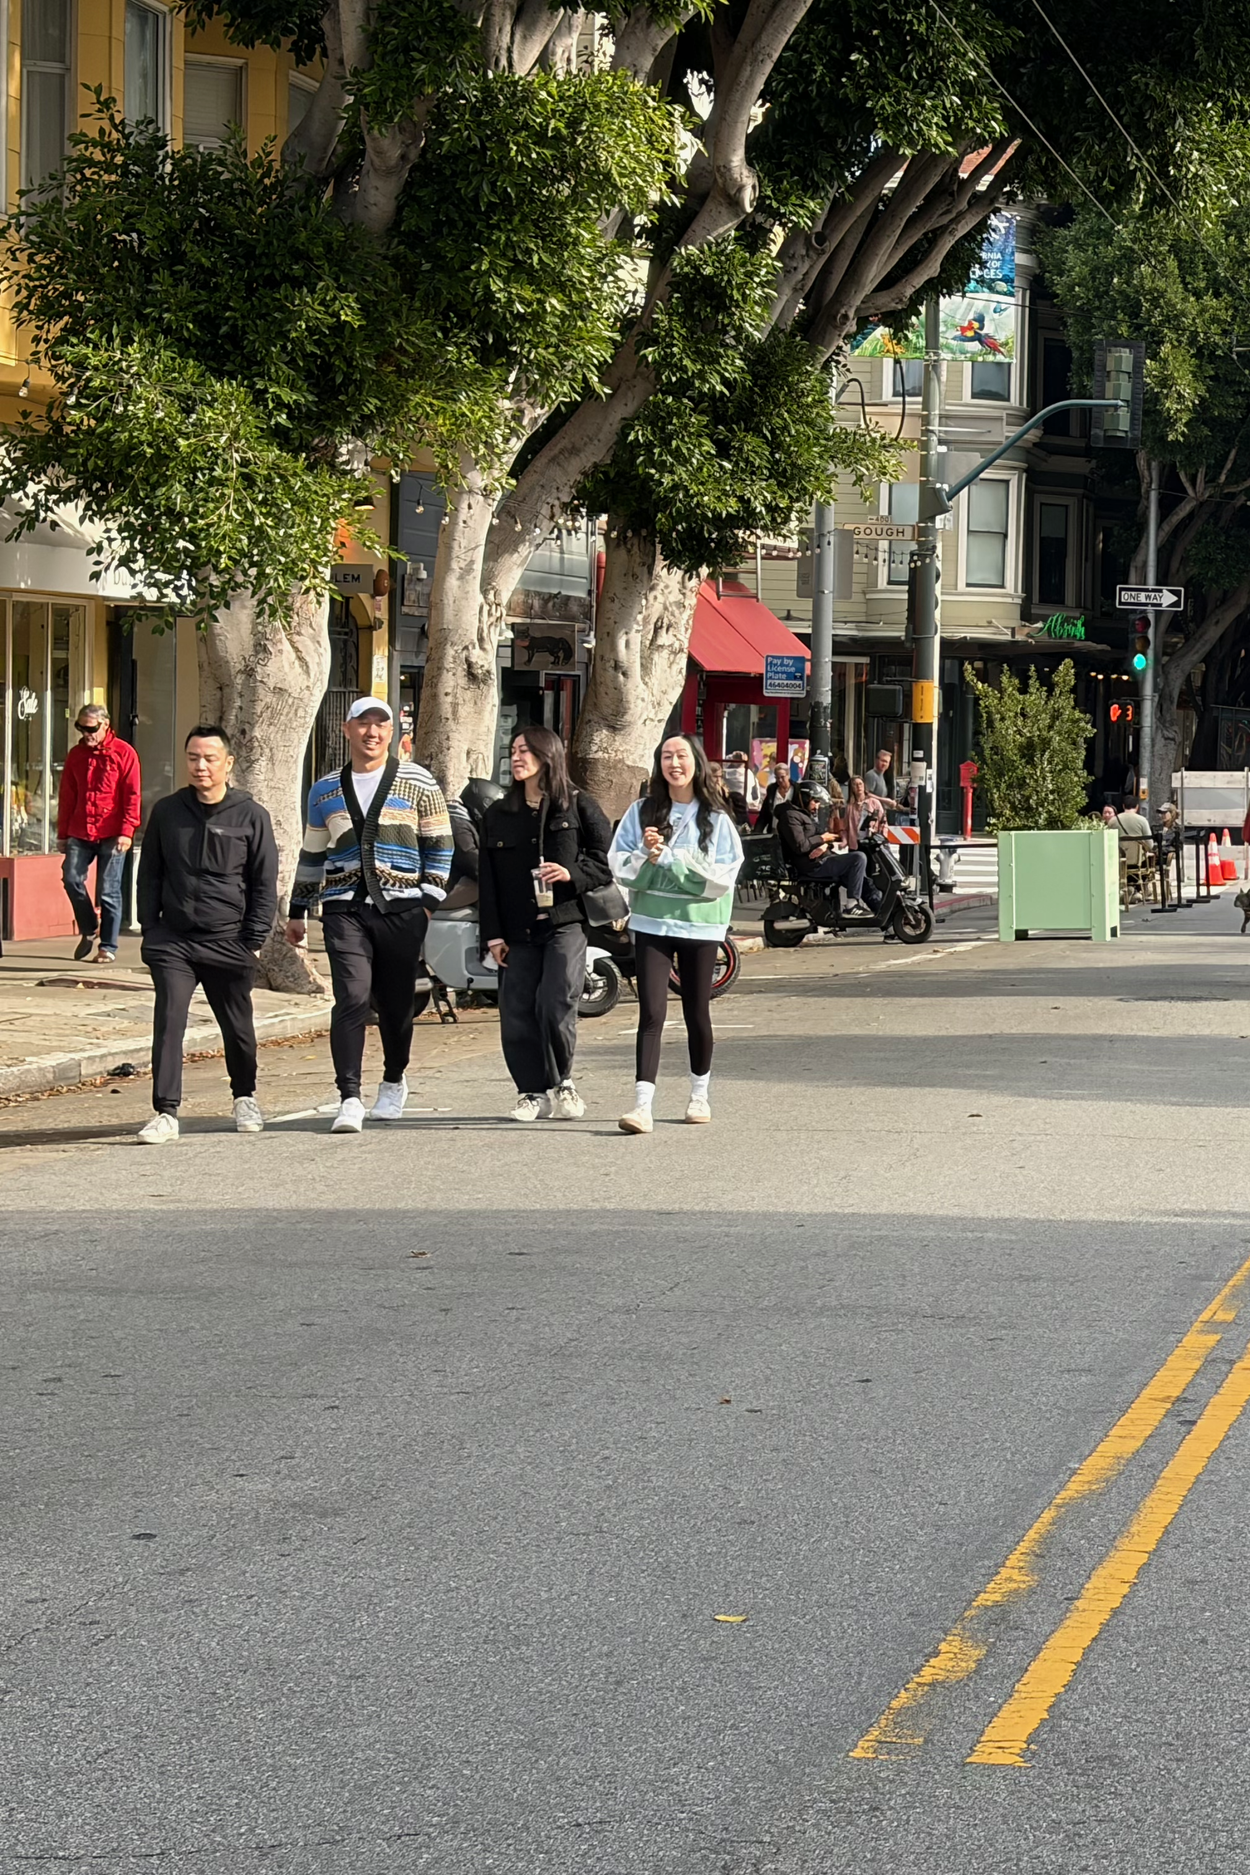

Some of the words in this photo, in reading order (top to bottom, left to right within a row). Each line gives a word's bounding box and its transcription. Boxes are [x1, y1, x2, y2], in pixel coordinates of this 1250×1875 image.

[853, 526, 906, 538] GOUGH
[335, 573, 361, 584] LEM
[1123, 592, 1142, 602] ONE
[1145, 593, 1164, 602] WAY
[767, 656, 782, 666] Pay
[783, 656, 794, 667] by
[767, 664, 796, 672] License
[767, 672, 787, 680] Plate
[1126, 704, 1134, 721] 3
